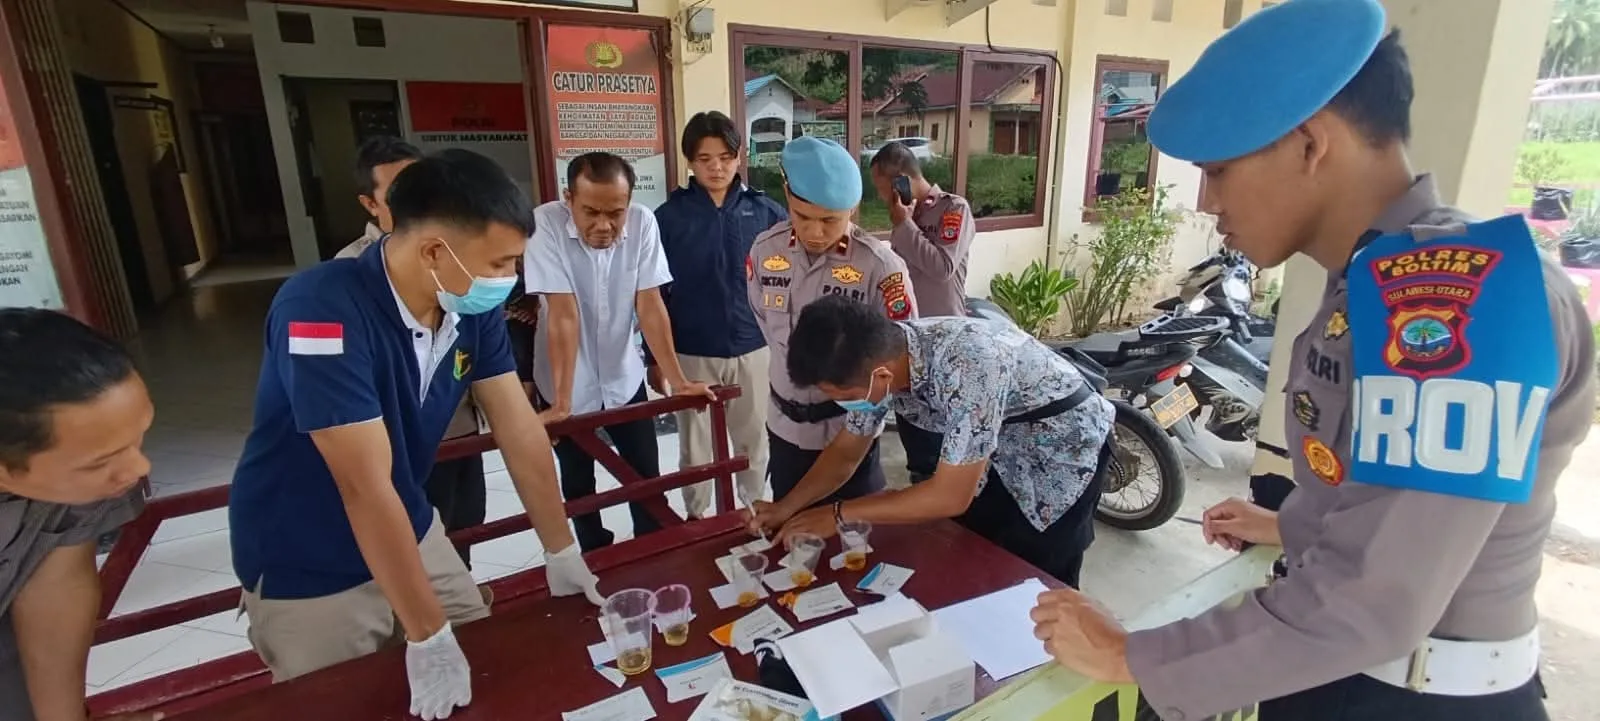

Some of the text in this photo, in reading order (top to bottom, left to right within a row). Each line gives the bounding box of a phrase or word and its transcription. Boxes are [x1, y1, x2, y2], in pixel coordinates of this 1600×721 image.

[553, 72, 656, 94] CATUR PRASETYA
[421, 134, 529, 142] UNTUK MASYARAKAT
[1378, 249, 1489, 272] POLRES
[1391, 260, 1471, 277] BOLTIM
